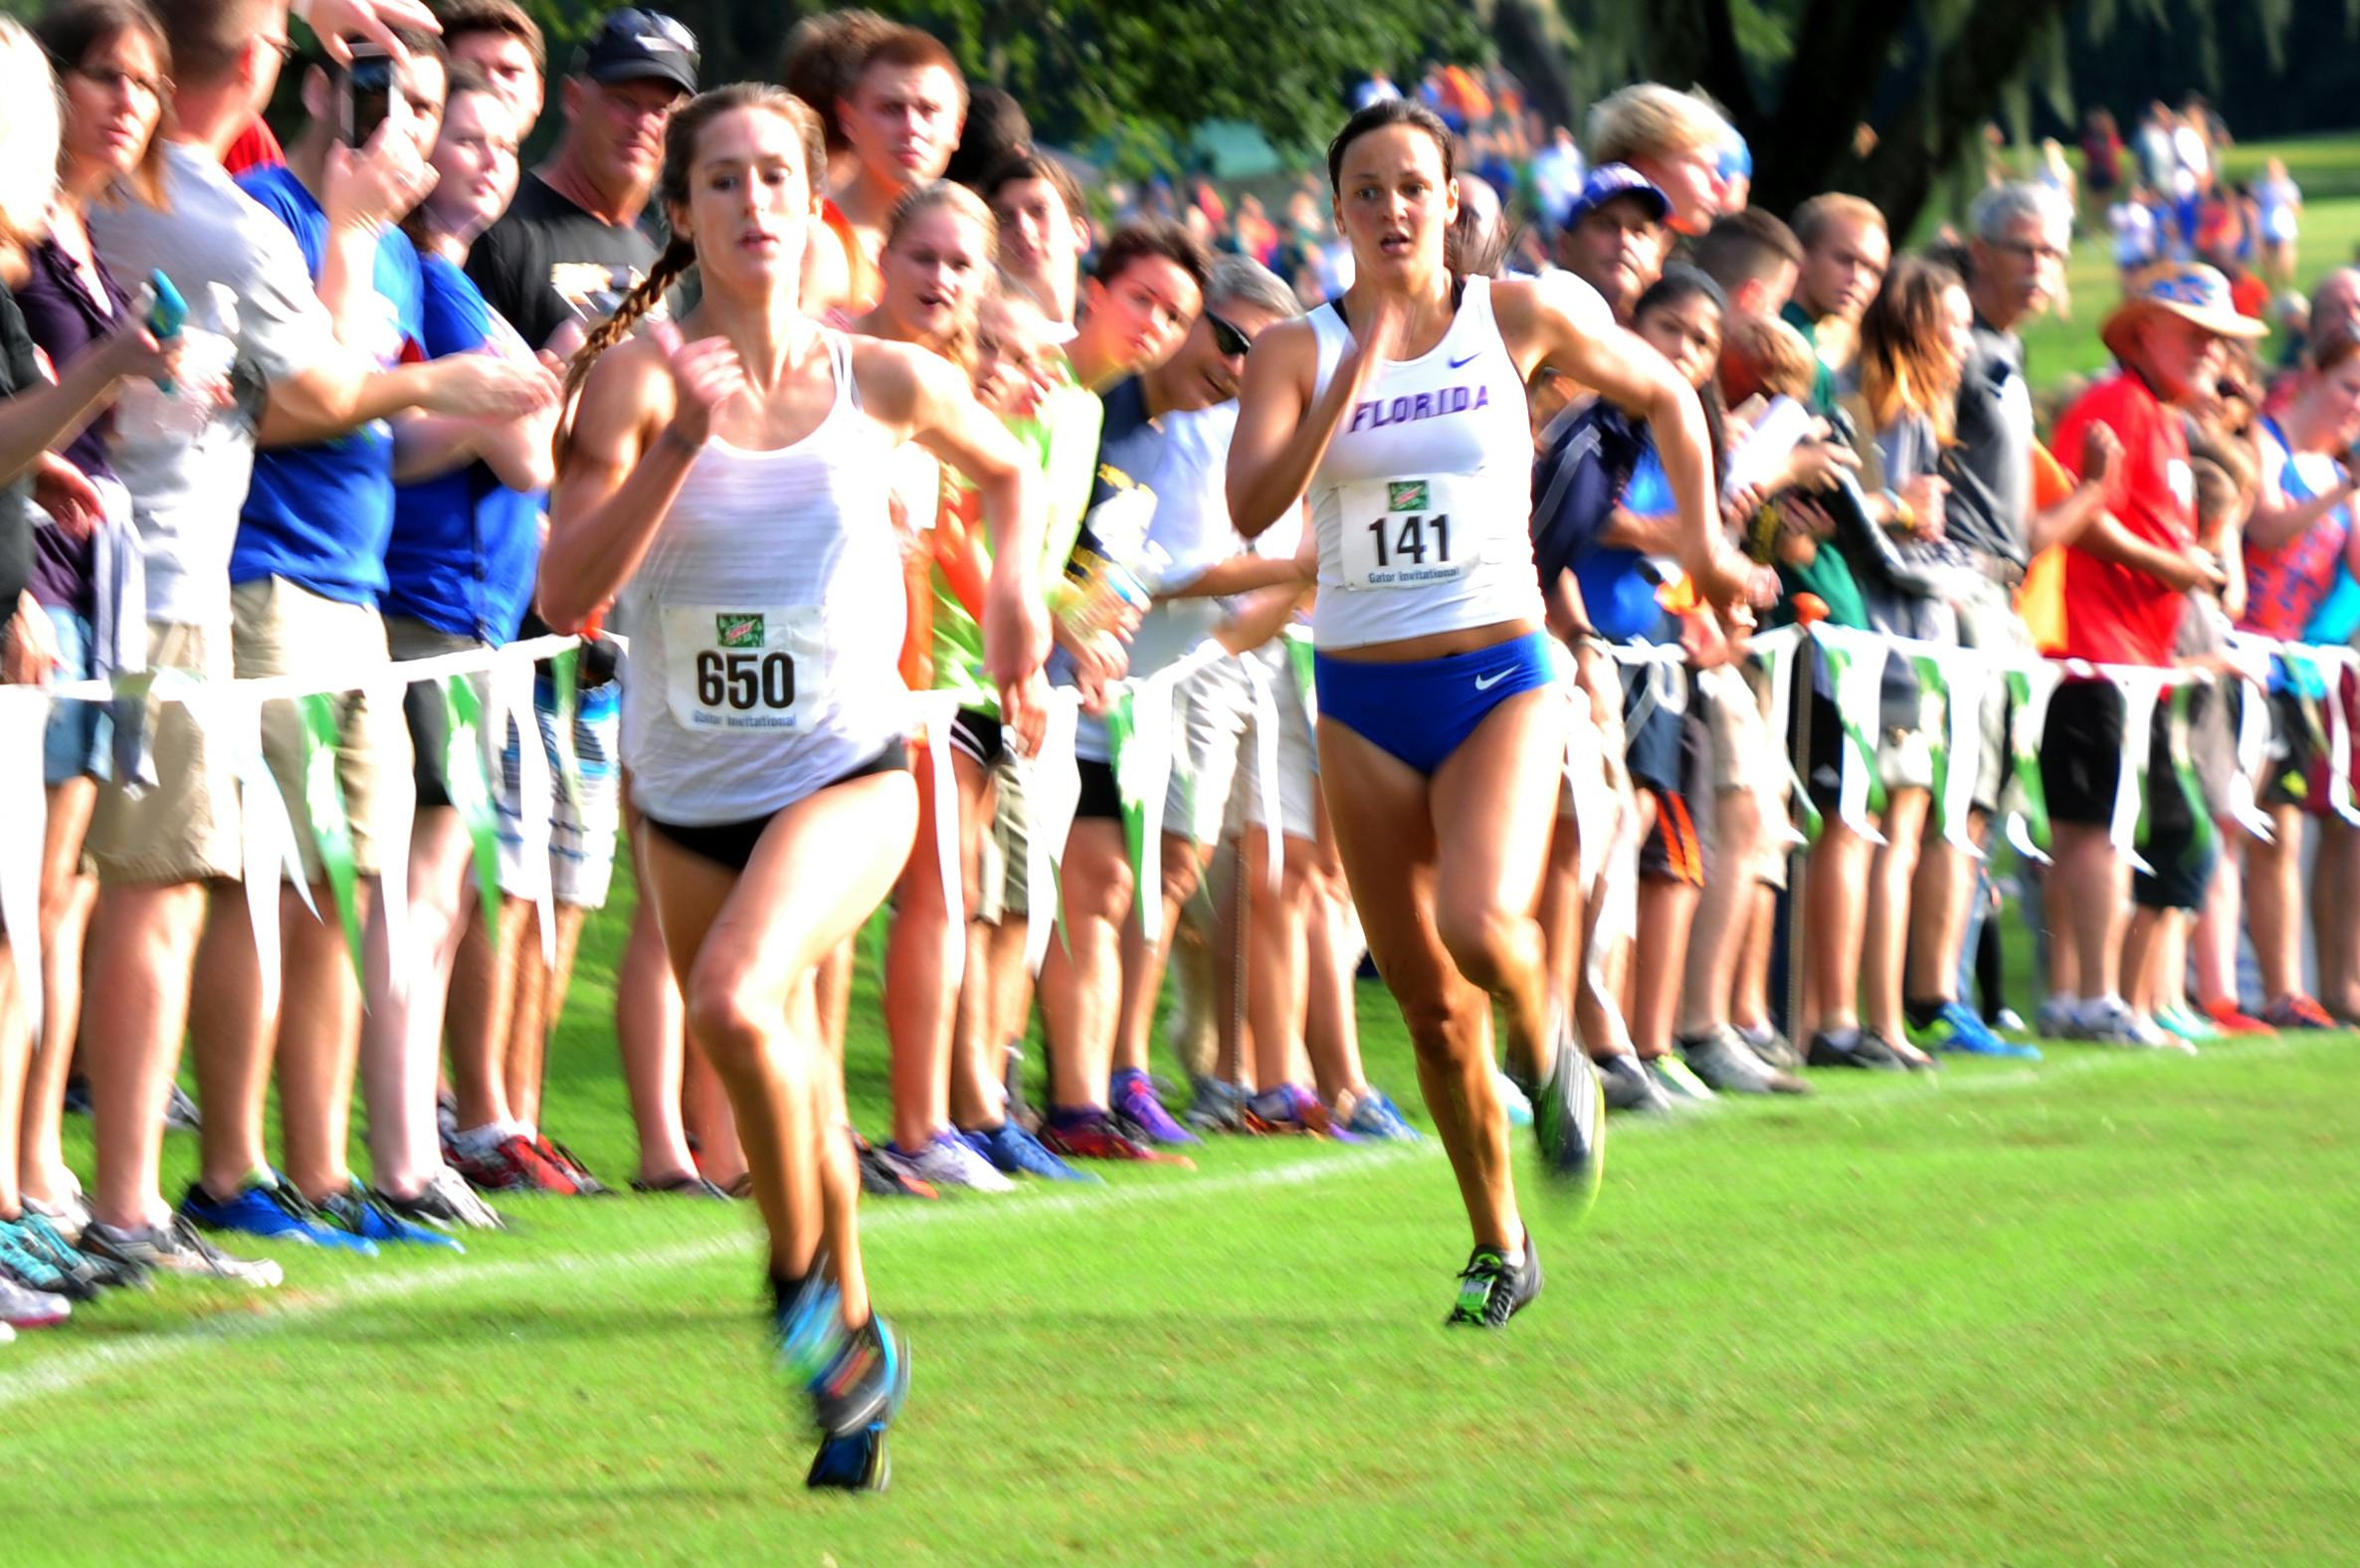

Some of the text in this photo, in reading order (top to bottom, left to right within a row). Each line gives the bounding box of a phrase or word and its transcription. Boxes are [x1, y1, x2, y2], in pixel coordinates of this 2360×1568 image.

[1347, 385, 1489, 434] FLORIDA
[1368, 514, 1450, 566] 141
[1368, 567, 1460, 583] Gator Invitational
[696, 650, 795, 709] 650
